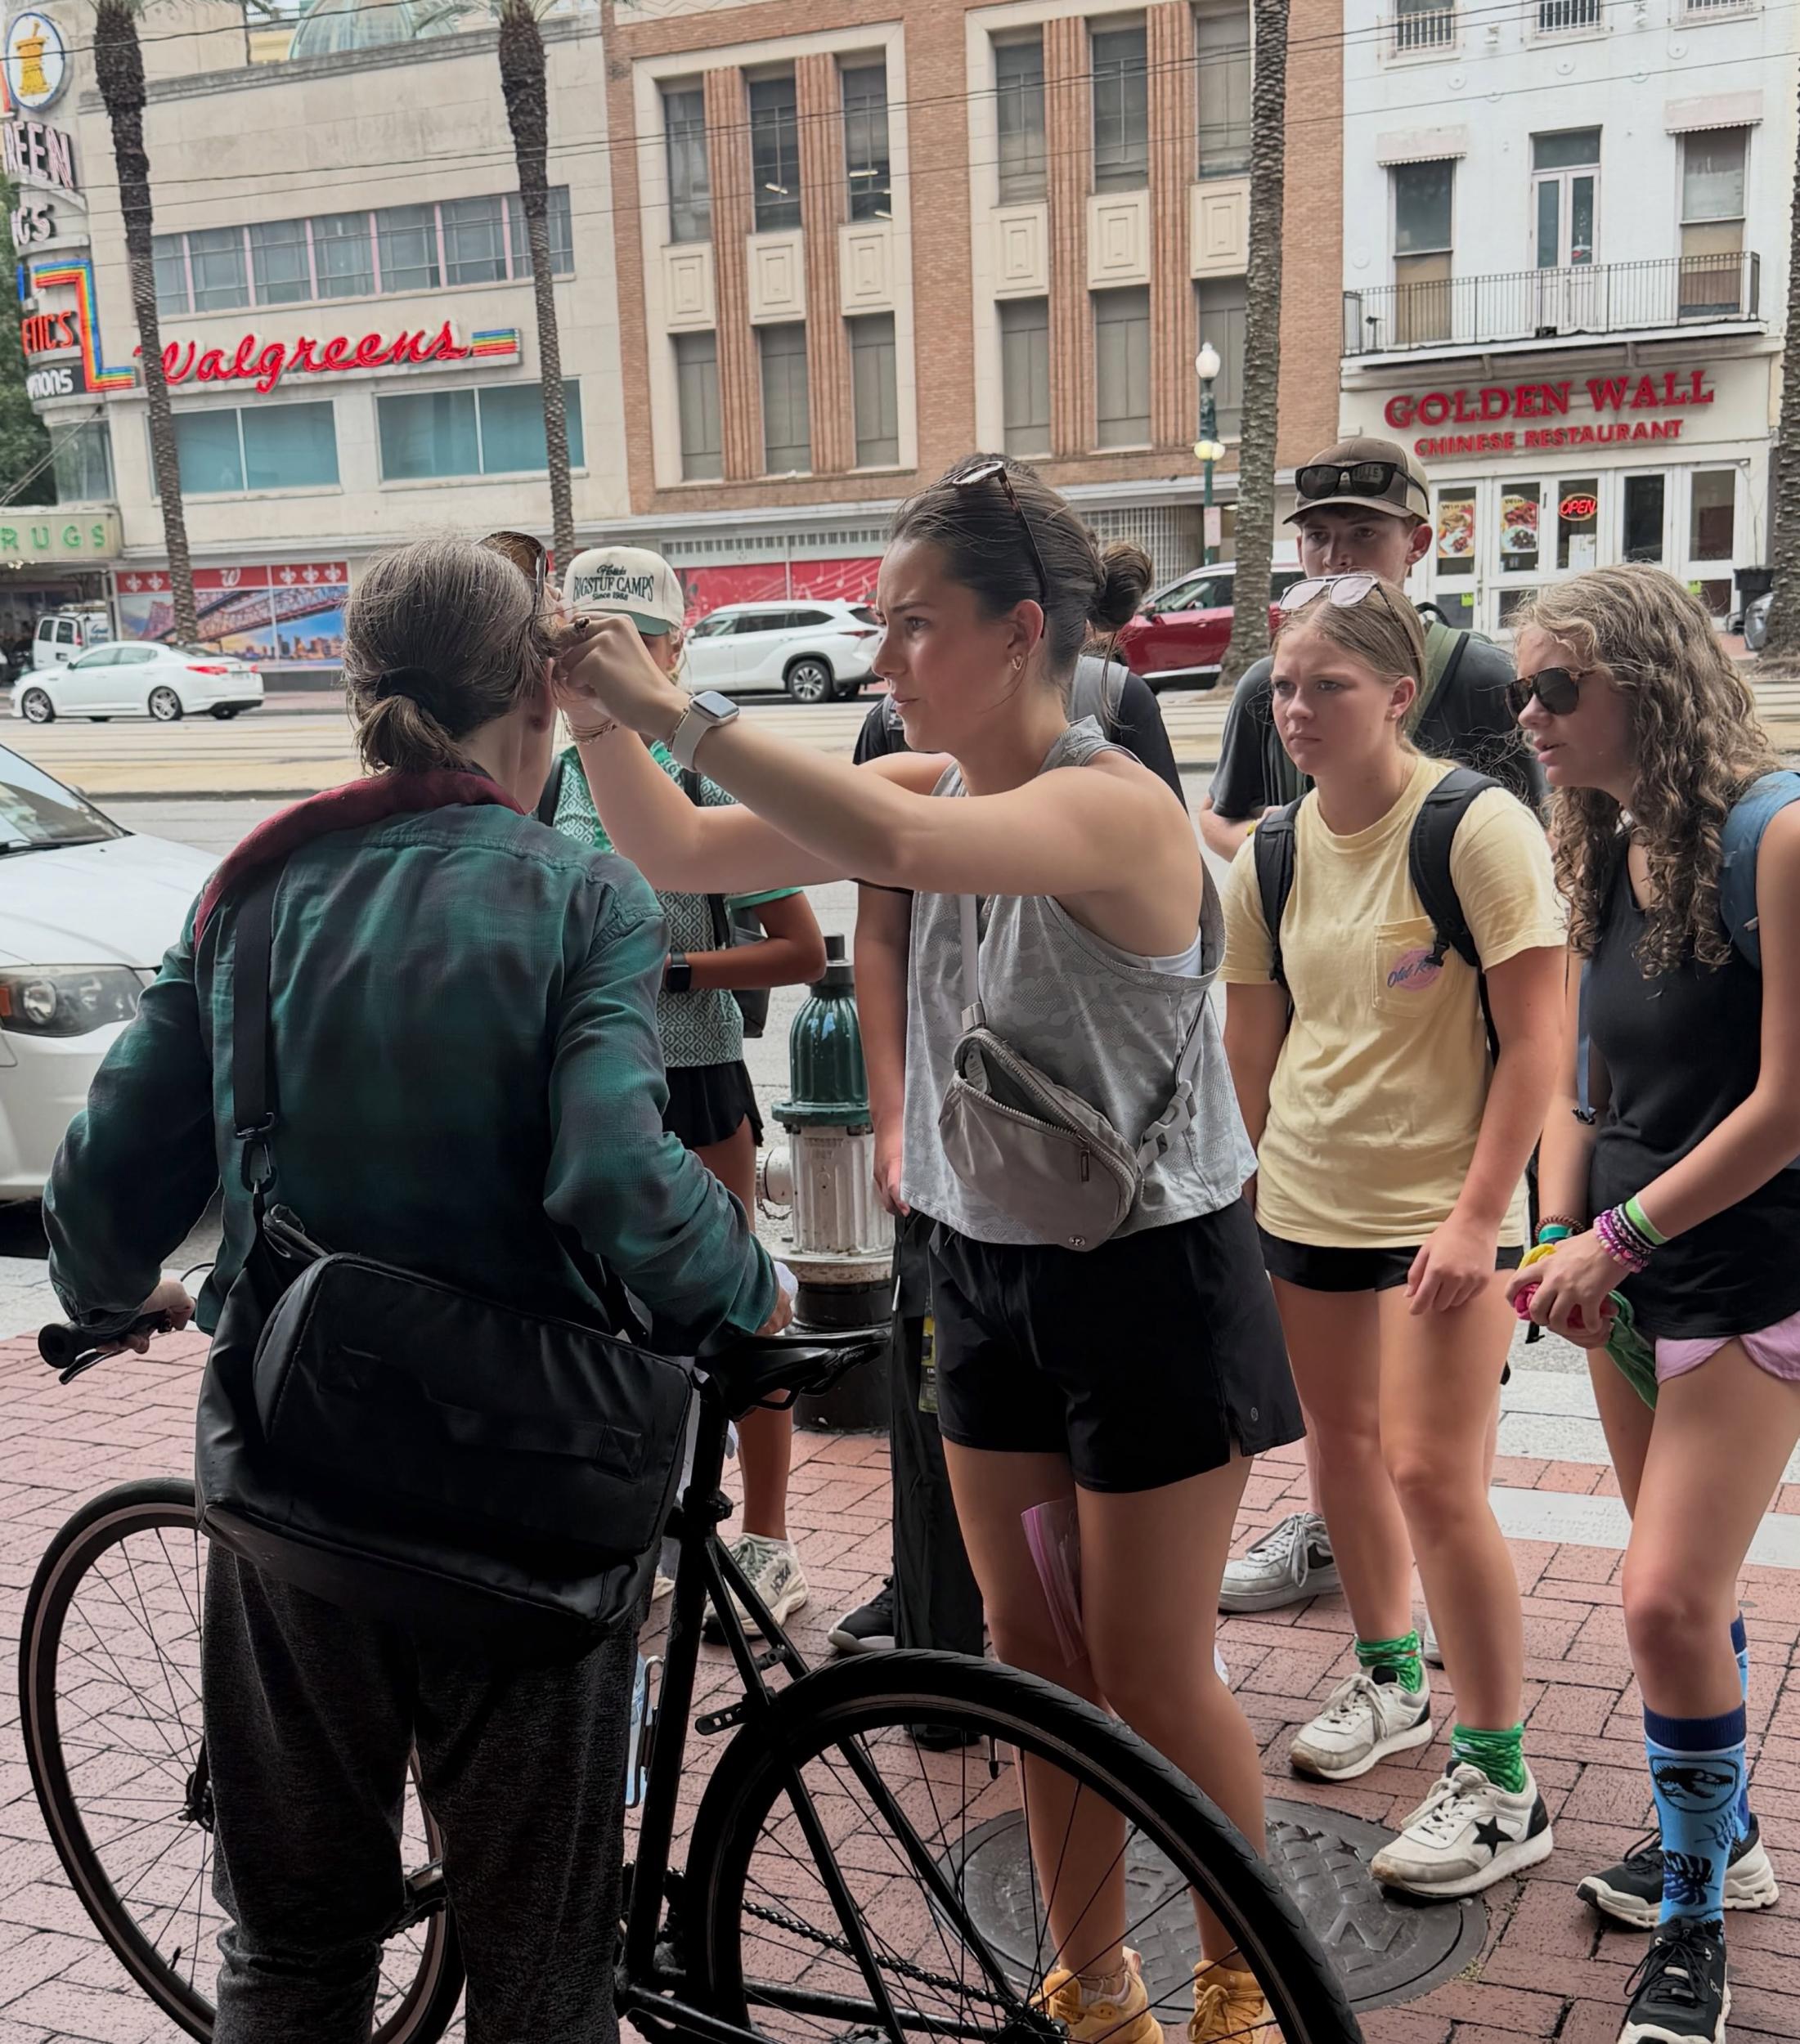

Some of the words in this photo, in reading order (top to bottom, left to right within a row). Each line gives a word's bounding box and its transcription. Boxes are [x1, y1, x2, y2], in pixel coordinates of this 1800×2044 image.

[133, 320, 469, 393] Walgreens
[1384, 381, 1572, 429] GOLDEN
[1586, 370, 1715, 413] WALL
[1414, 431, 1515, 458] CHINESE
[1524, 419, 1685, 450] RESTAURANT
[1560, 500, 1596, 515] OPEN
[1, 523, 105, 551] RUGS
[617, 575, 654, 602] CAMPS
